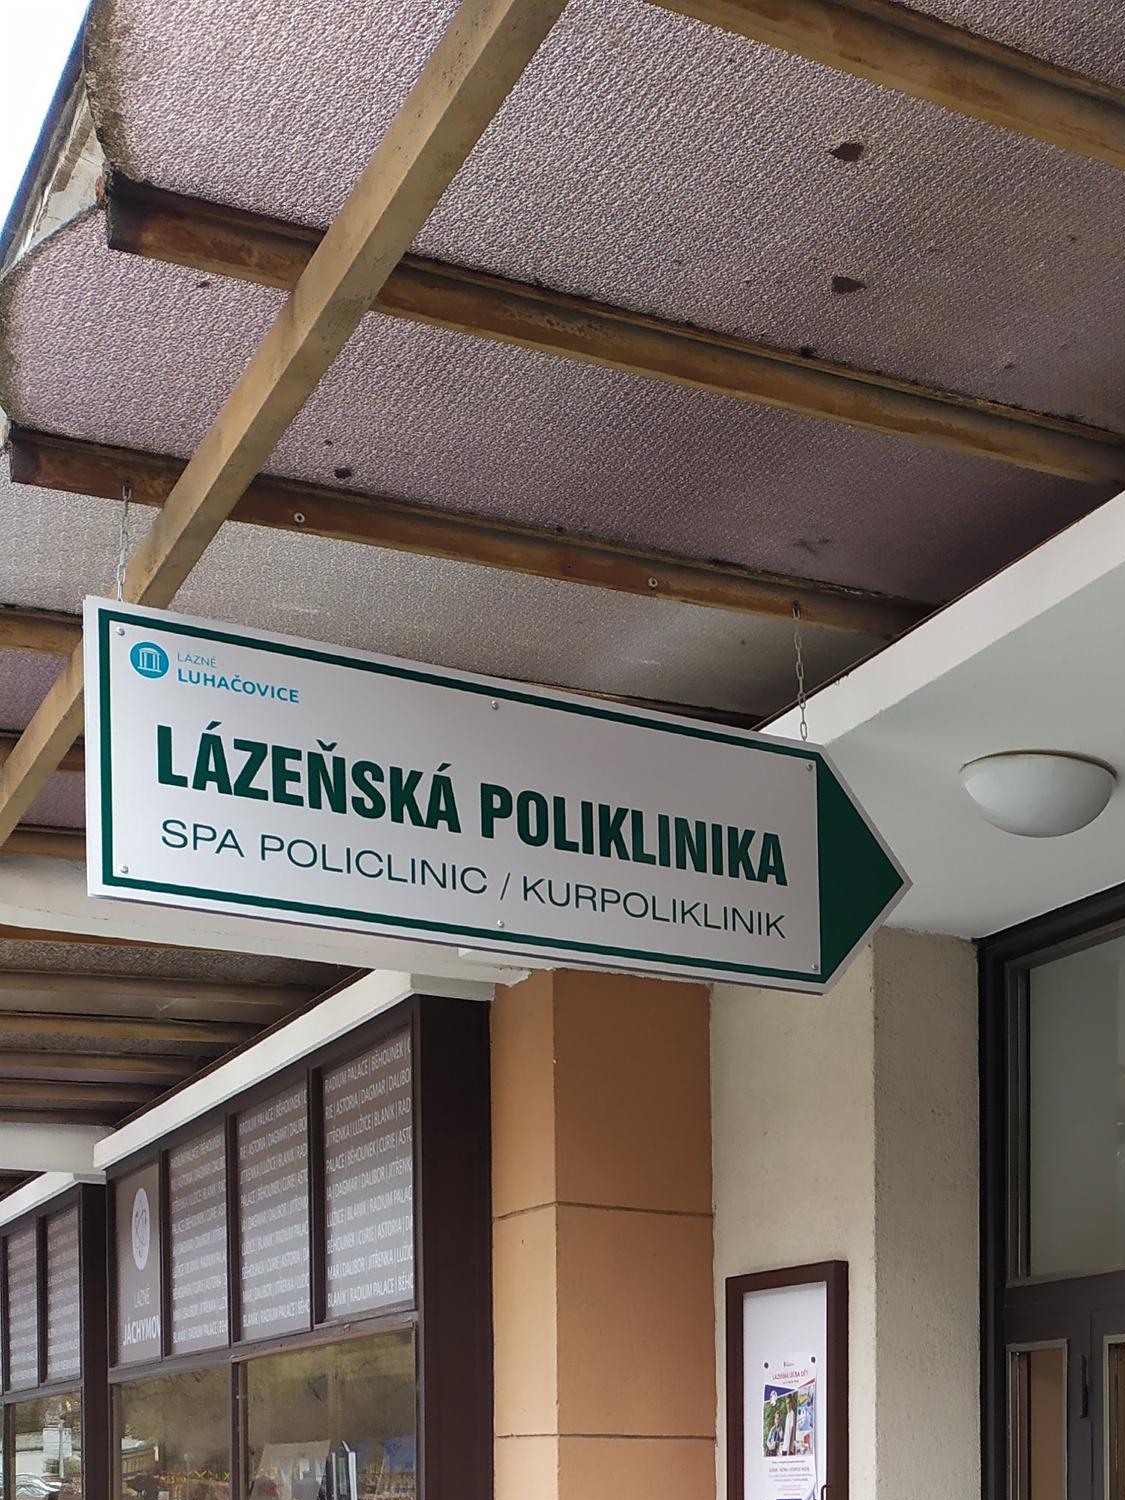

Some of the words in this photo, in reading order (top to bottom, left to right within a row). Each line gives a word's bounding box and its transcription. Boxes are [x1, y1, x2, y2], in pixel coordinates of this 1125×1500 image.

[177, 671, 300, 704] LUHAČOVICE
[156, 720, 461, 834] LÁZEŇSKÁ
[480, 781, 788, 887] POLIKLINIKA
[161, 818, 245, 859] SPA
[260, 833, 488, 896] POLICLINIC
[522, 873, 787, 940] KURPOLIKLINIK
